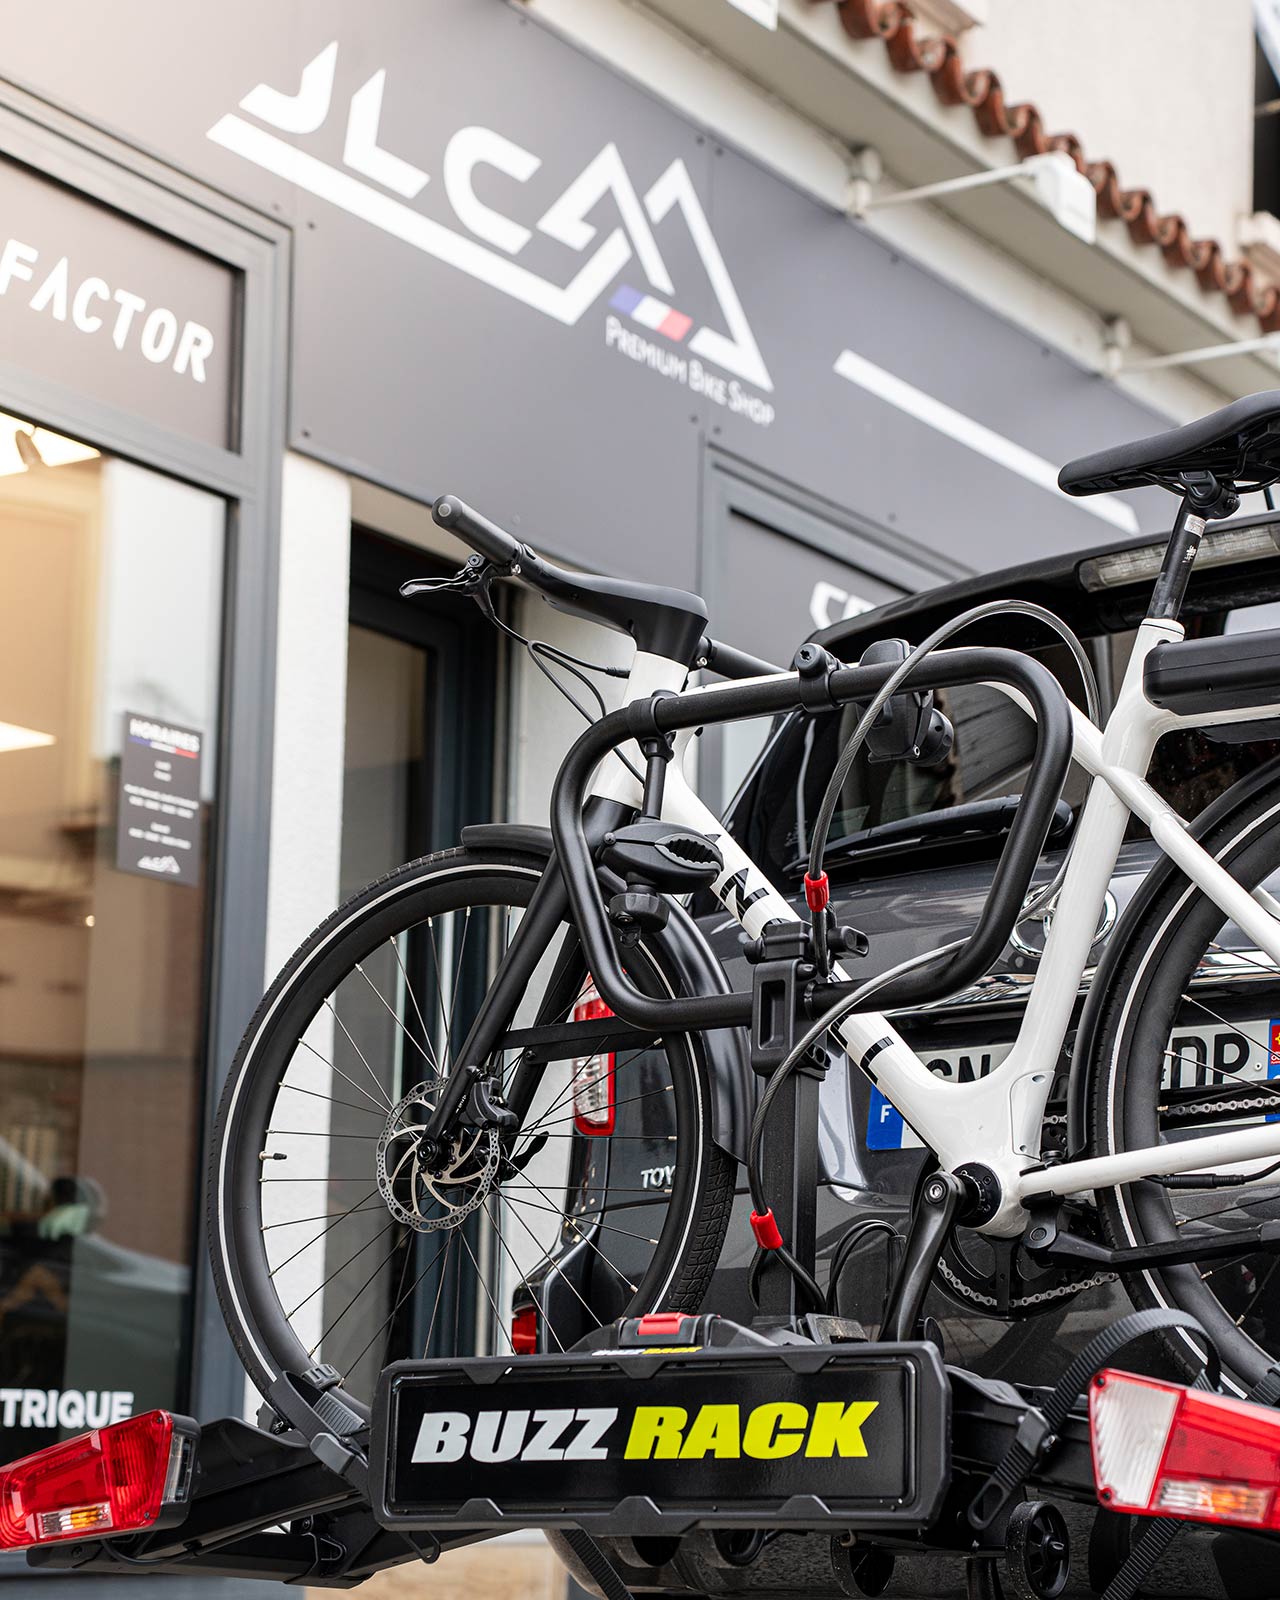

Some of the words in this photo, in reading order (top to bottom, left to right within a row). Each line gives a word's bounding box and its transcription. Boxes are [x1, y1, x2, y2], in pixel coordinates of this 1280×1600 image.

[0, 239, 214, 383] FACTOR
[880, 1104, 893, 1123] F
[0, 1387, 135, 1429] TRIQUE
[410, 1407, 619, 1463] BUZZ
[623, 1401, 880, 1460] RACK
